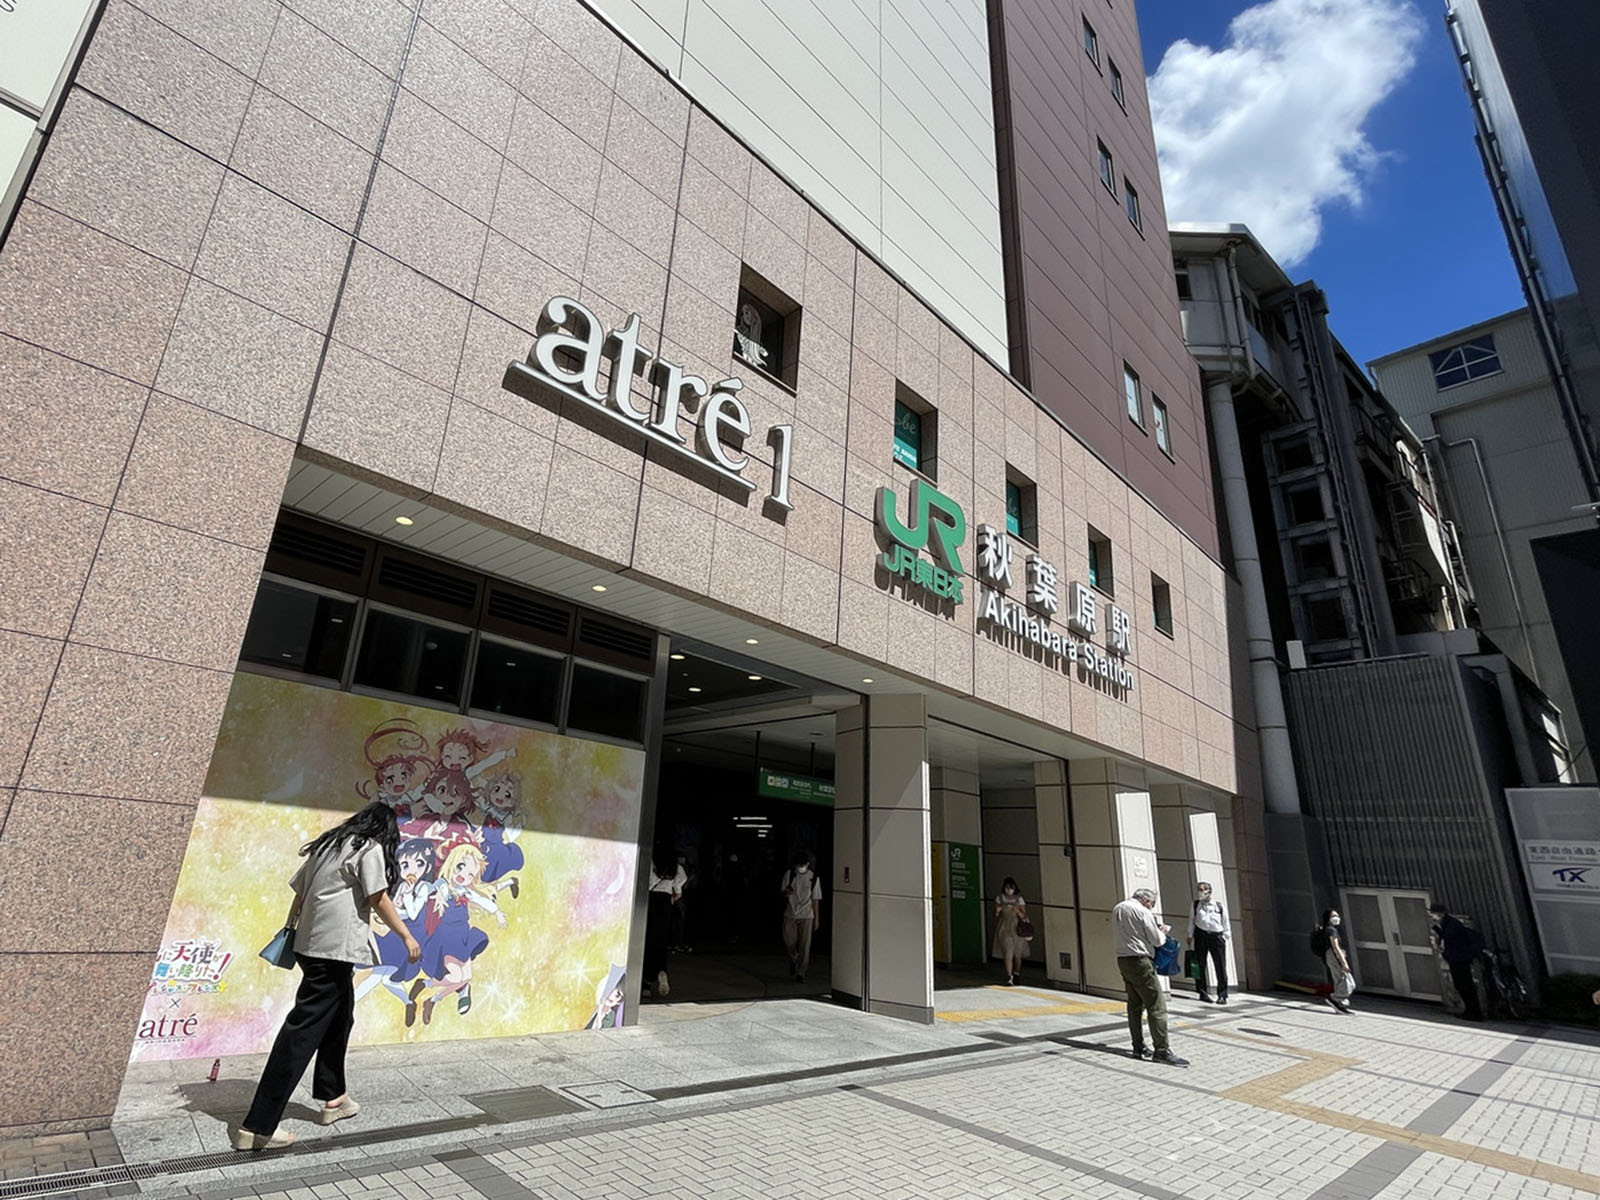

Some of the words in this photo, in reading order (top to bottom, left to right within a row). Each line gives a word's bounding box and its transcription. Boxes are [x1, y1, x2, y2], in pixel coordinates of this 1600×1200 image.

[535, 295, 752, 472] atré
[883, 480, 967, 577] JR
[884, 543, 964, 606] JR東日本
[983, 525, 1132, 652] 秋葉原駅
[985, 593, 1078, 662] Akihabara
[1083, 642, 1135, 692] Station
[1552, 867, 1593, 883] TX
[138, 1013, 198, 1039] atré
